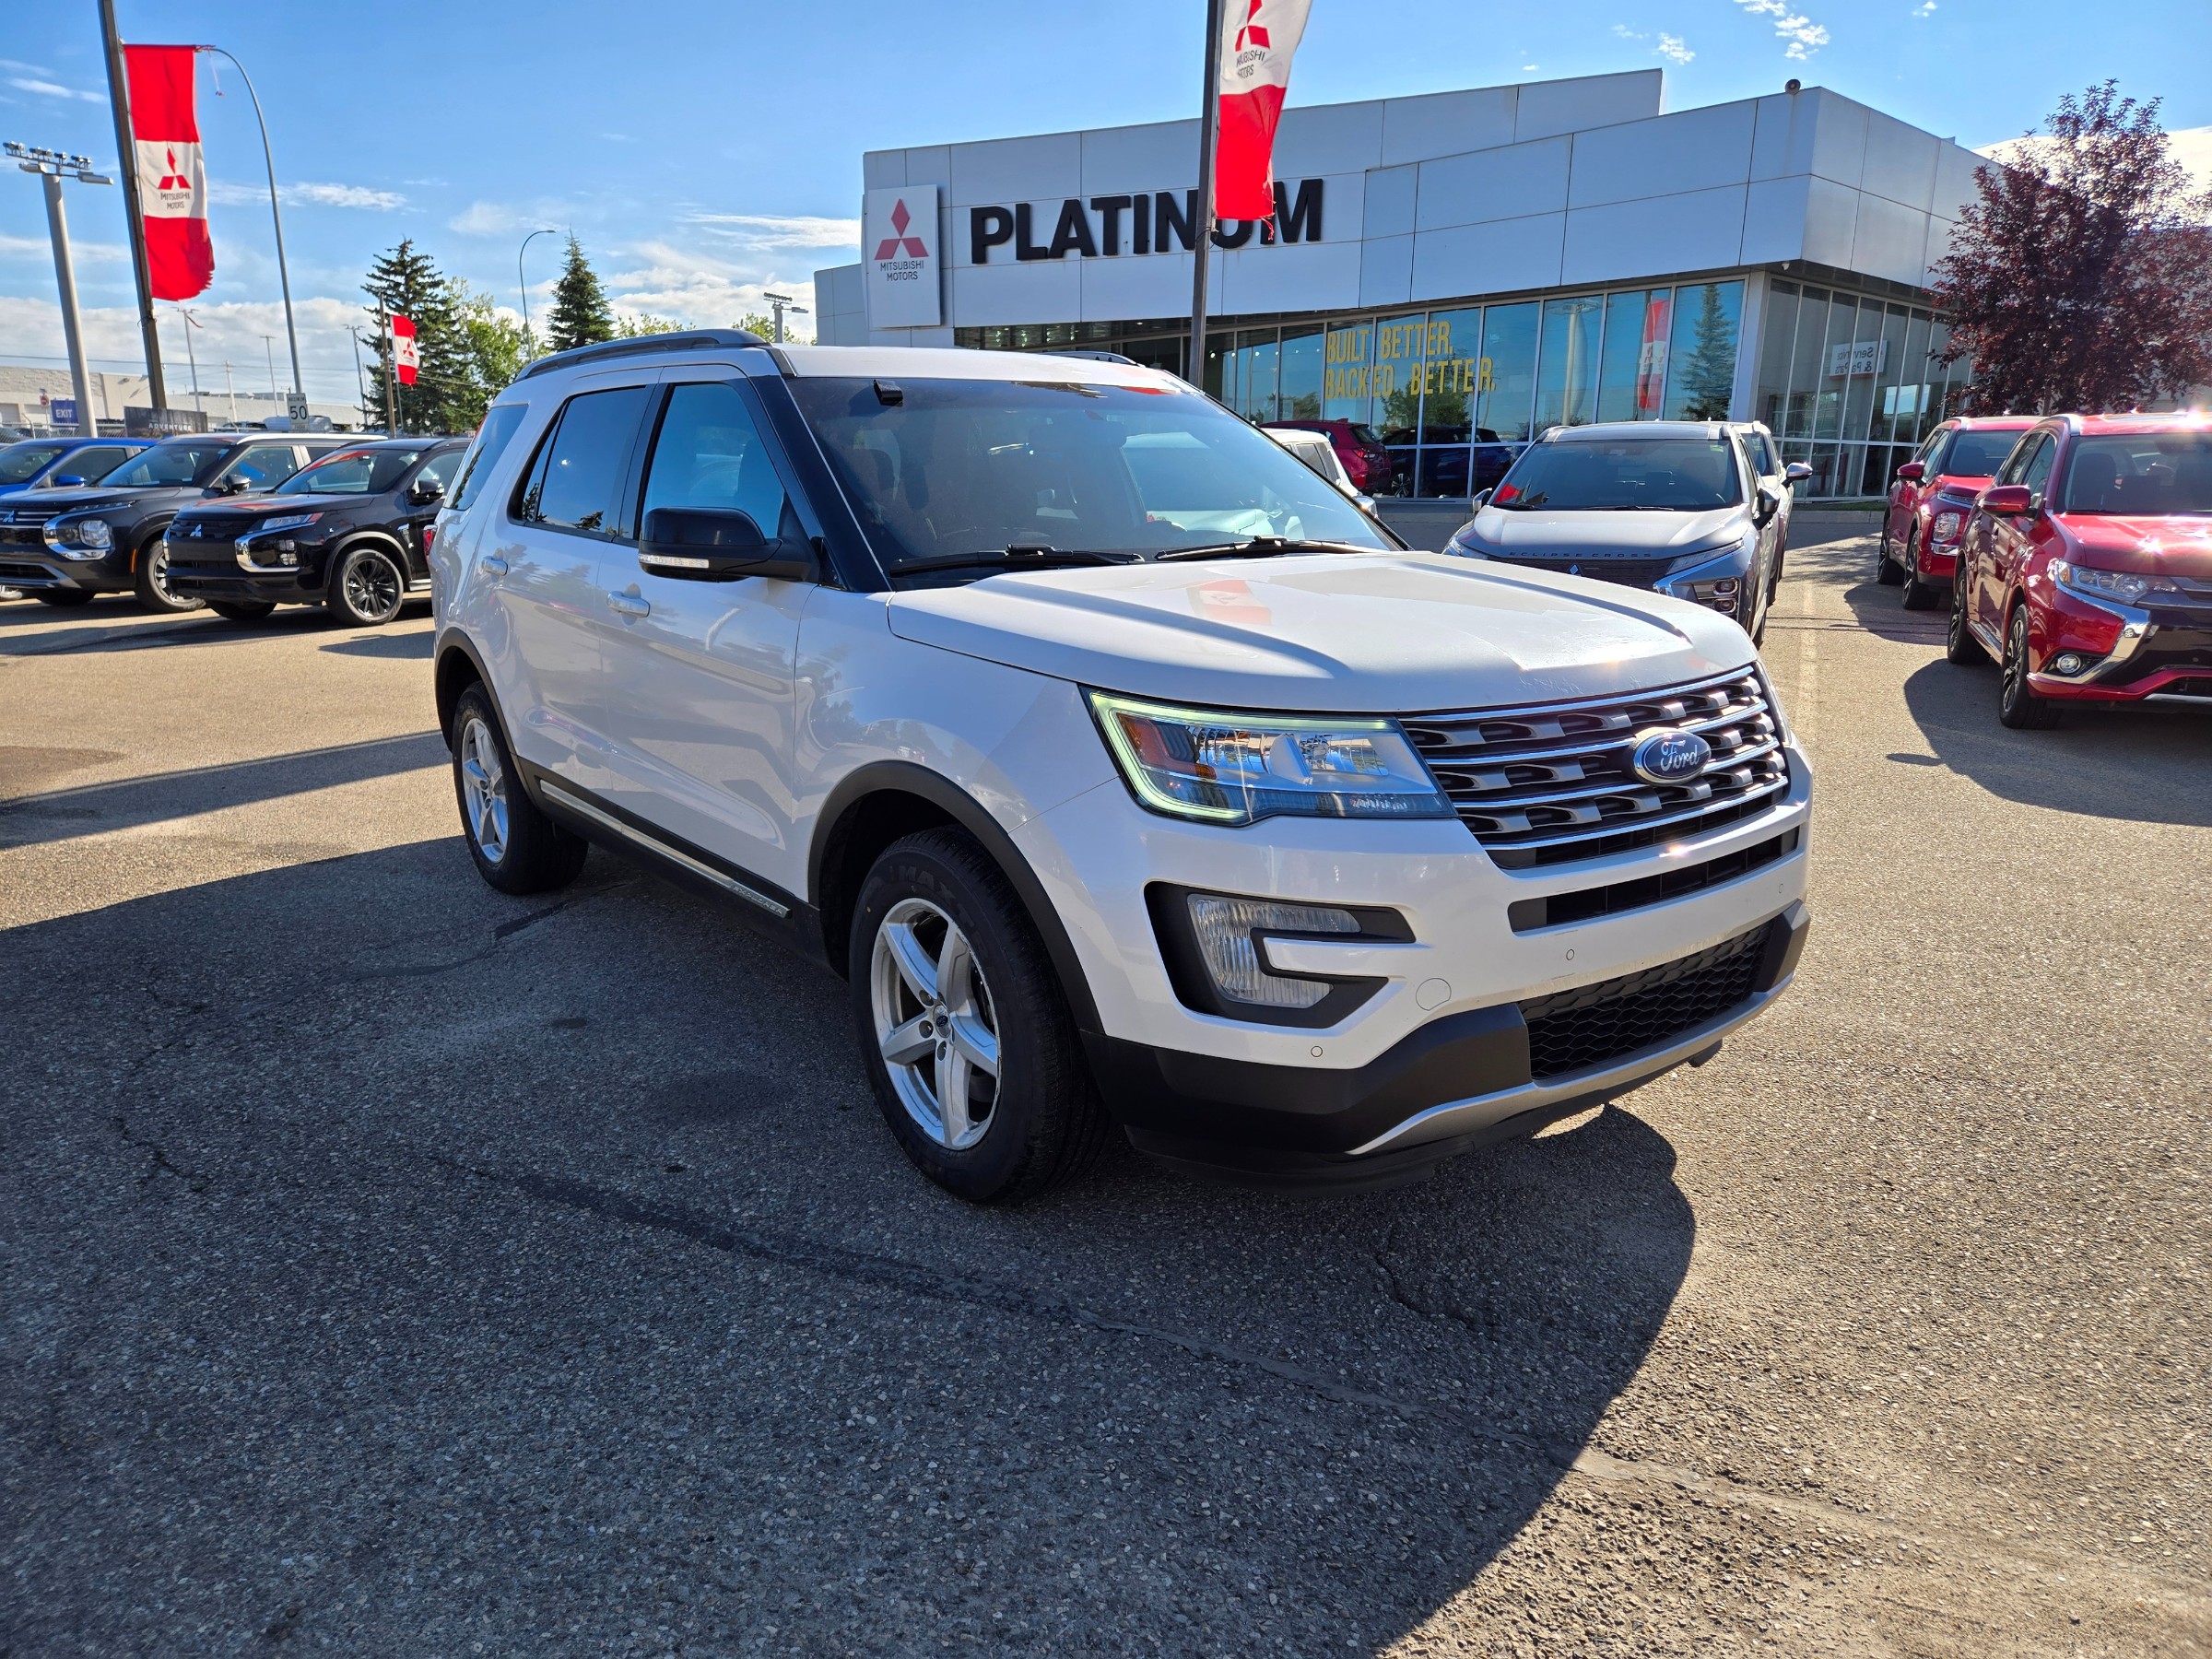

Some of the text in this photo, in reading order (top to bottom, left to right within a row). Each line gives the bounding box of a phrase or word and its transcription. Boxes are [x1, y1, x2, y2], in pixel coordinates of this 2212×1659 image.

[880, 260, 924, 272] MITSUBISHI
[887, 271, 919, 281] MOTORS
[1325, 321, 1454, 364] BUILT BETTER.
[1324, 357, 1496, 400] BACKED BETTER.
[55, 409, 73, 418] EXIT
[289, 406, 308, 419] 50
[148, 422, 192, 431] ADVENTURE
[1660, 739, 1700, 771] Ford
